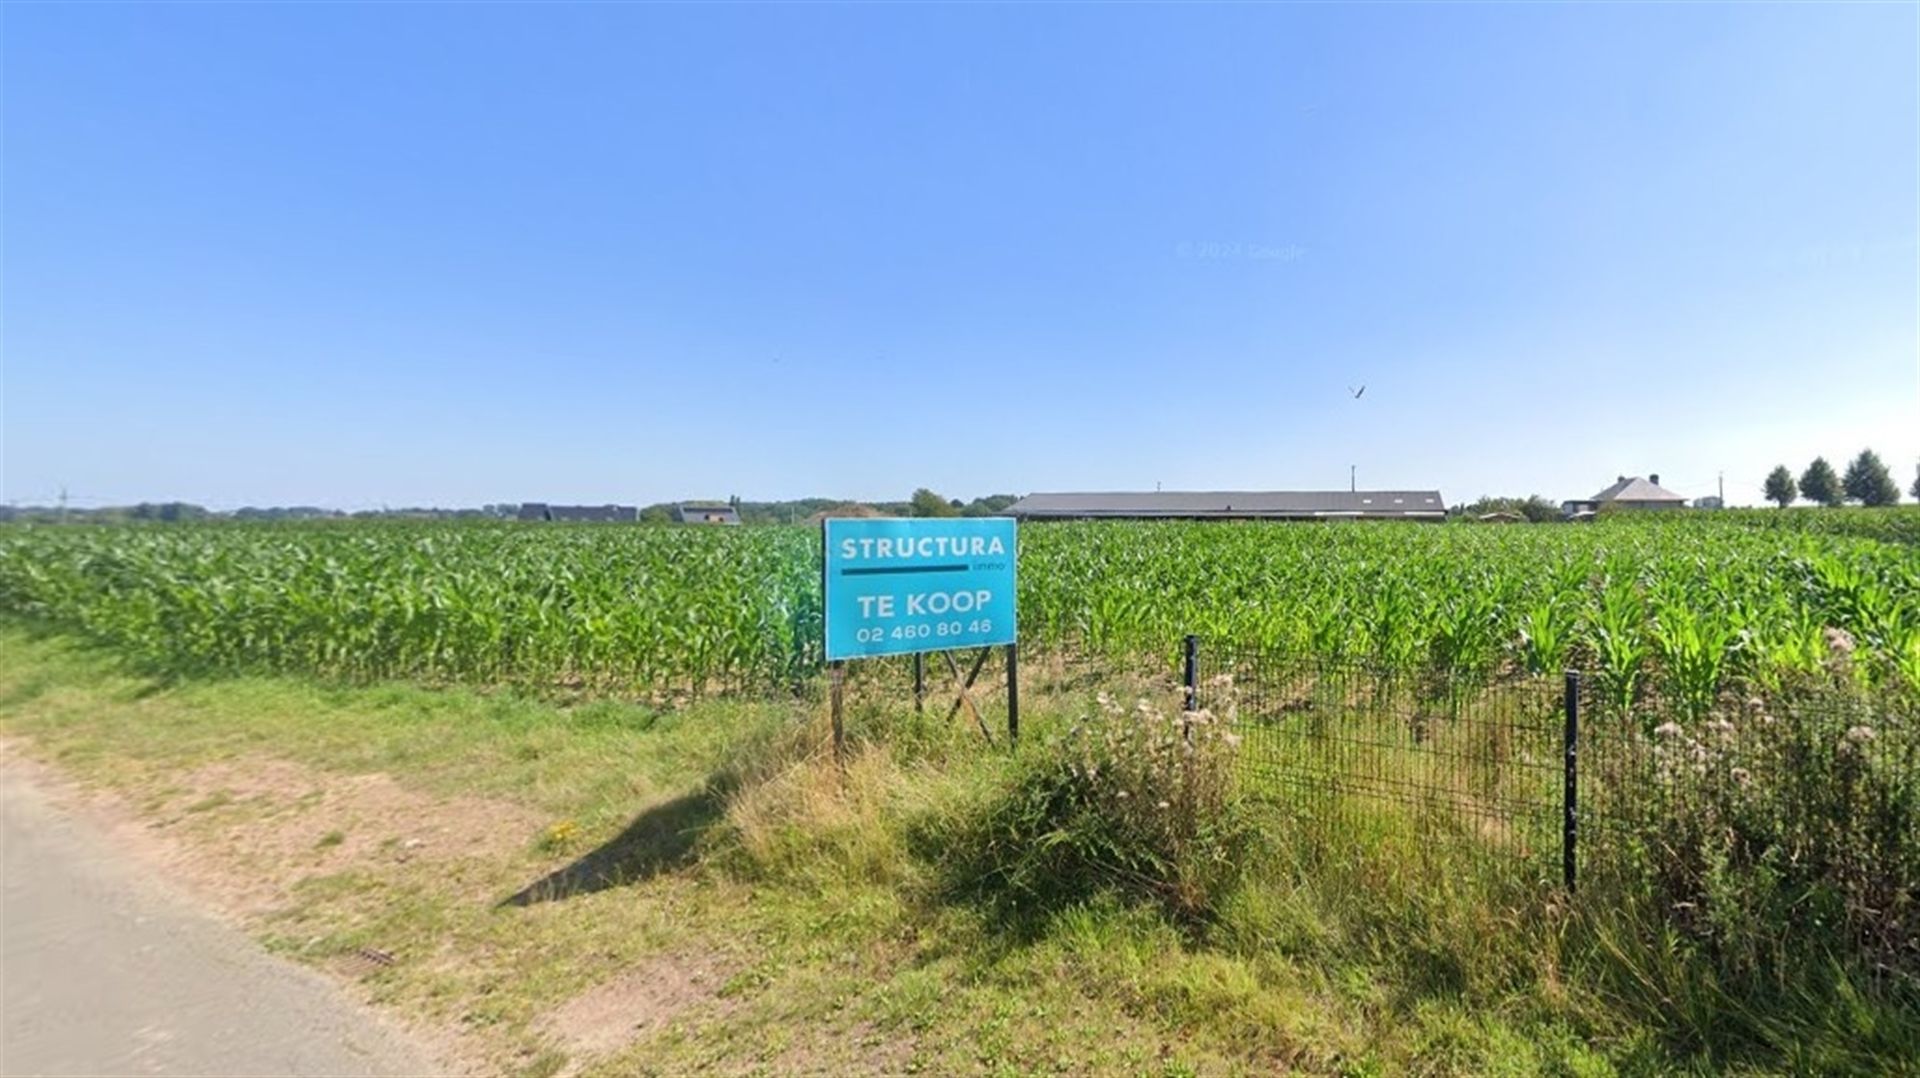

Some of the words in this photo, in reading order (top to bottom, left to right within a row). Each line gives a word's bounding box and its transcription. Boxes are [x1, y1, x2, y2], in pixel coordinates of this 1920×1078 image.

[842, 536, 1005, 559] STRUCTURA
[857, 596, 895, 619] TE
[907, 590, 992, 615] KOOP
[856, 628, 883, 643] 02
[891, 624, 930, 640] 460
[936, 621, 962, 636] 80
[968, 619, 992, 633] 46
